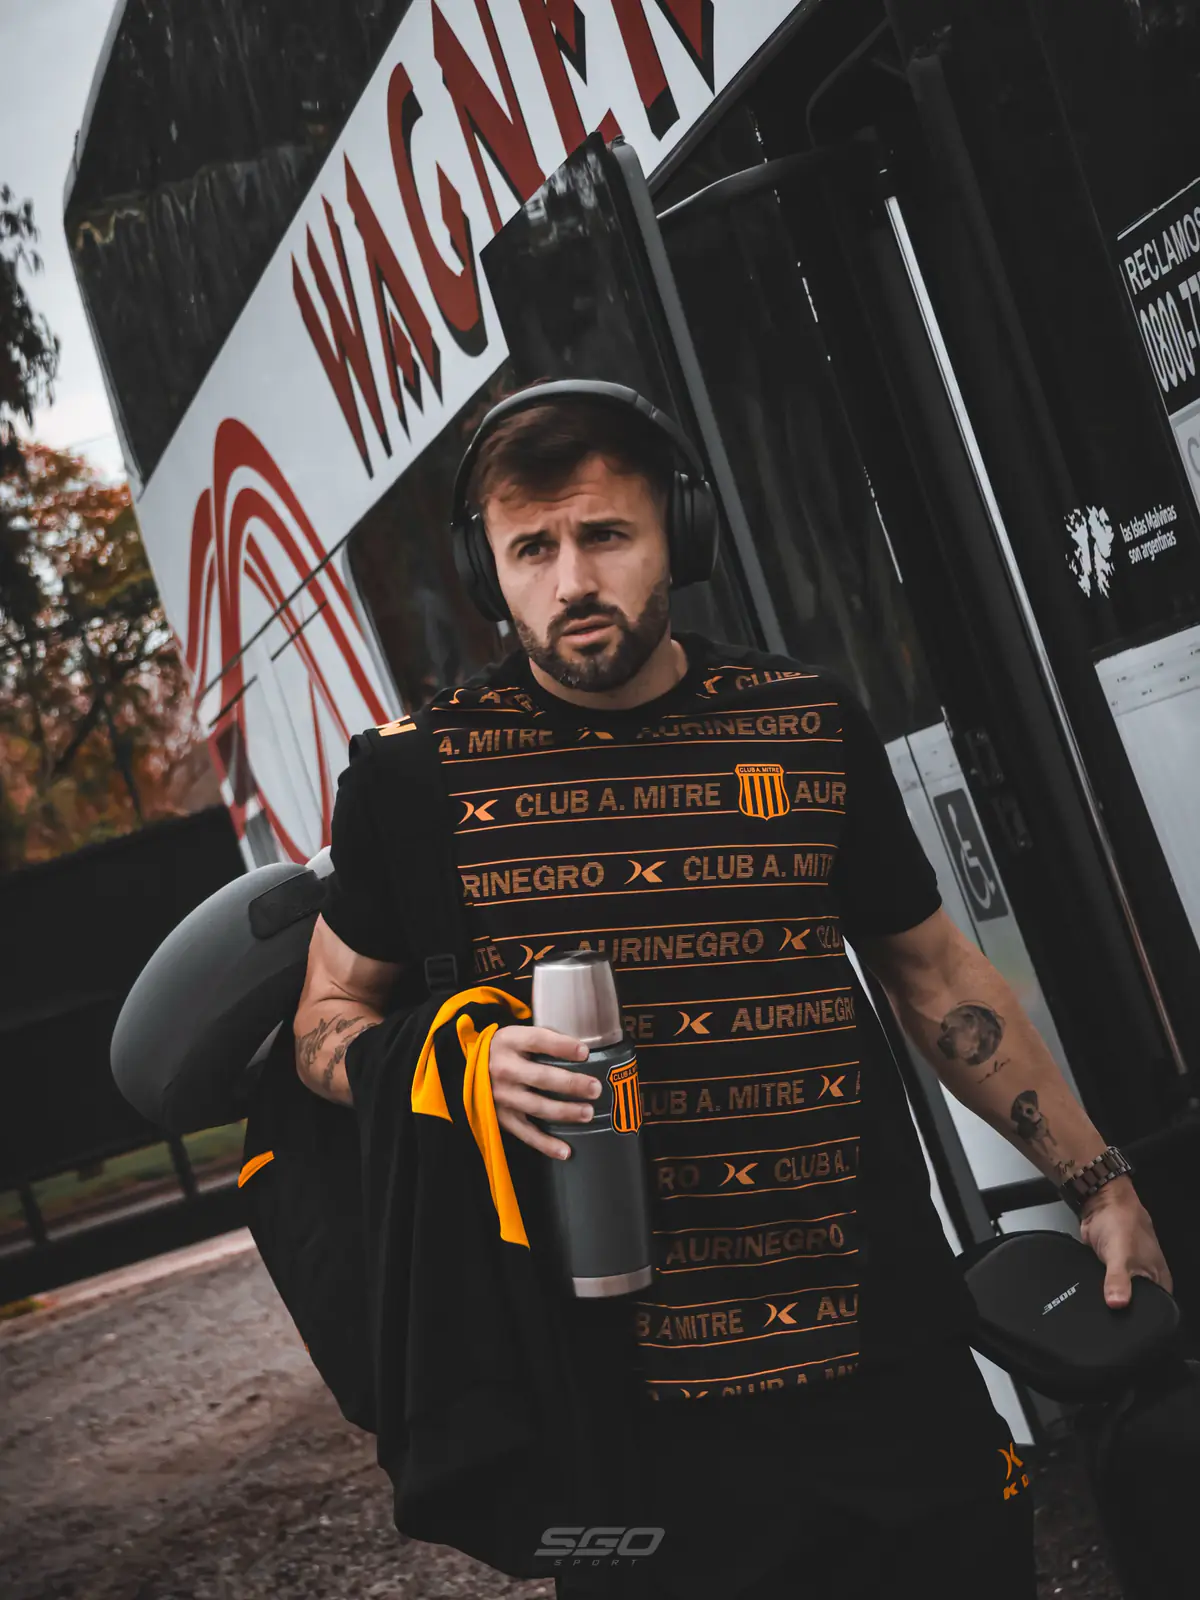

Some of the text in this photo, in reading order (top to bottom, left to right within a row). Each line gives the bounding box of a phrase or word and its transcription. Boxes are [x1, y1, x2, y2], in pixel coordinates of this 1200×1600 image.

[1144, 504, 1177, 531] Malvinas
[1129, 530, 1177, 564] son argentinas
[468, 728, 554, 754] MITRE
[515, 780, 847, 818] CLUB A. MITRE AUR
[460, 861, 605, 898] RINEGRO
[683, 854, 754, 882] CLUB
[761, 853, 787, 878] A.
[730, 996, 854, 1033] AURINEGR
[696, 1088, 721, 1114] A.
[728, 1079, 805, 1110] MITRE
[774, 1150, 830, 1183] CLUB
[666, 1223, 845, 1265] AURINEGRO
[1042, 1282, 1079, 1315] BOSE
[674, 1308, 744, 1341] MITRE
